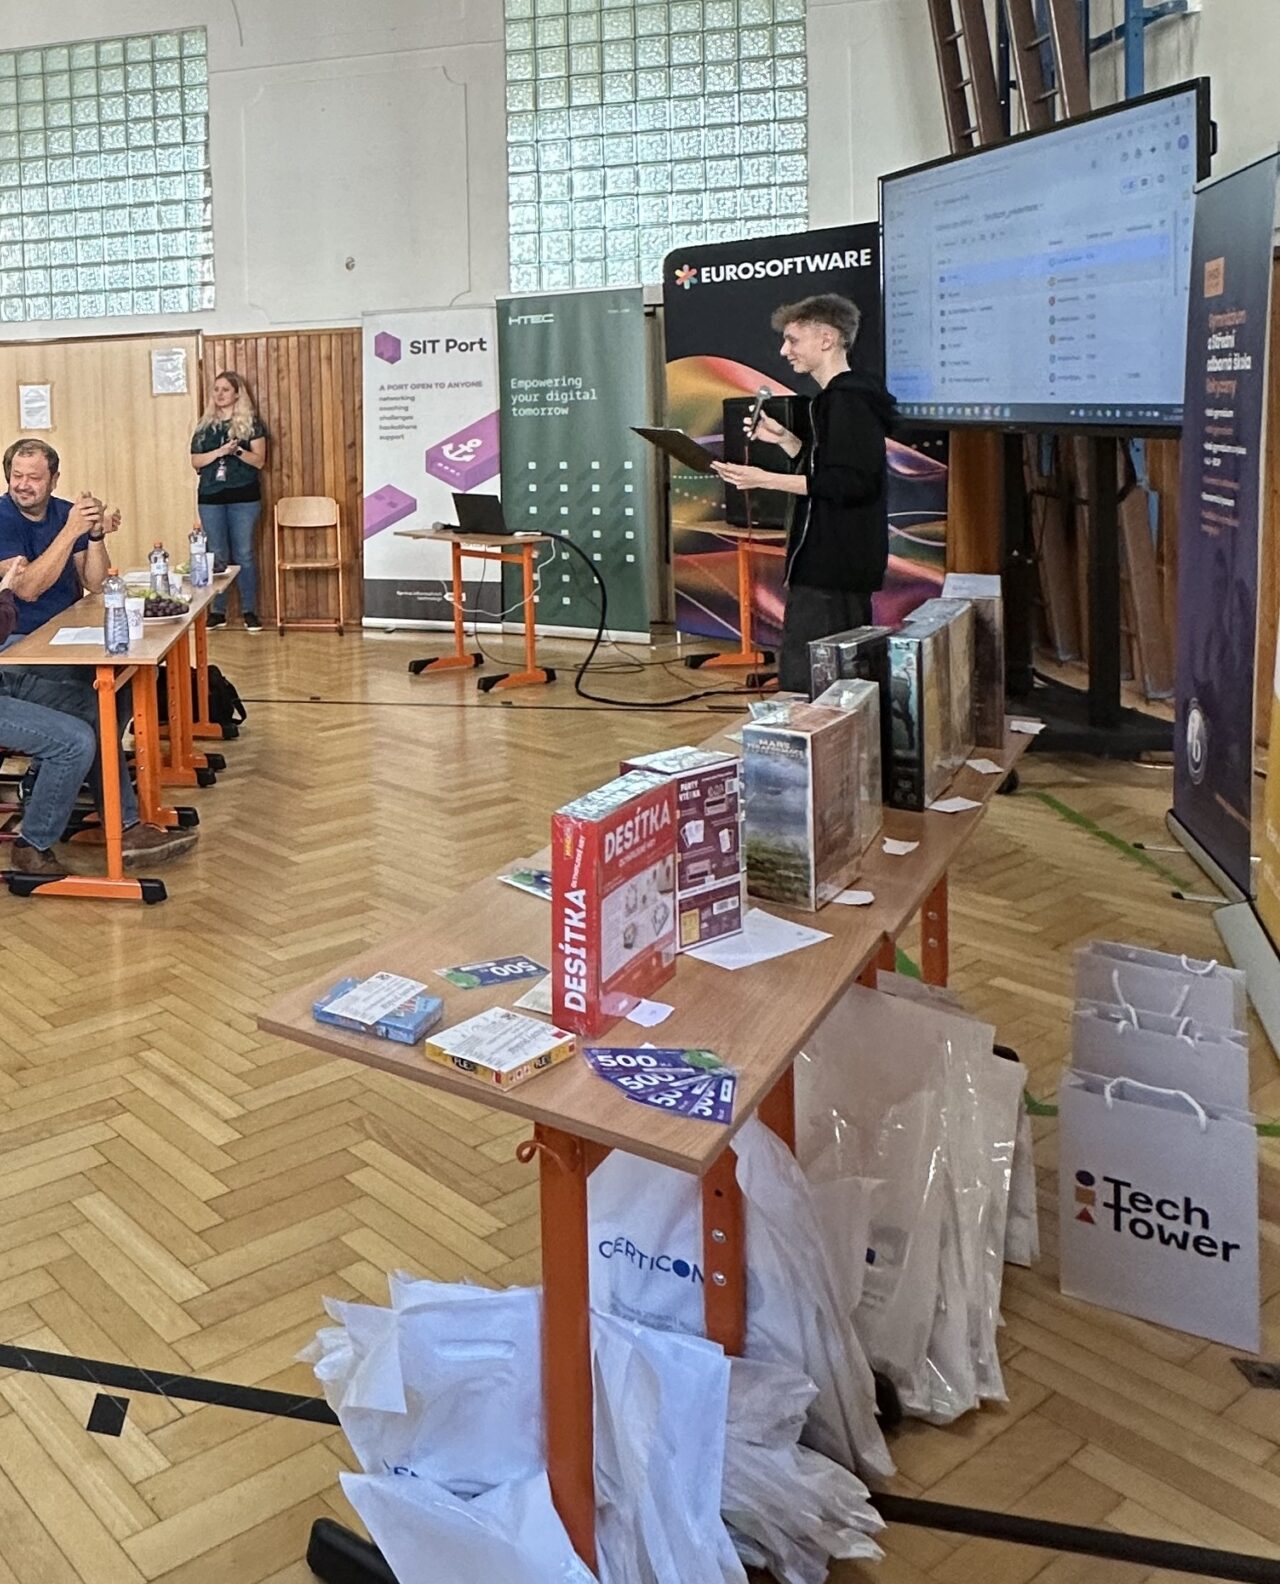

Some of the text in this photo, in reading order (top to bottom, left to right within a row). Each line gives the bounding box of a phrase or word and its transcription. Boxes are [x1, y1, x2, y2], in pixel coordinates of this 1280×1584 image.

[700, 248, 872, 284] EUROSOFTWARE
[508, 313, 554, 326] HTEC
[410, 337, 487, 355] SIT Port
[1233, 352, 1251, 370] škola
[379, 380, 483, 391] A PORT OPEN TO ANYONE
[510, 376, 583, 390] Empowering
[511, 388, 598, 405] your digital
[379, 414, 413, 422] challenges
[511, 406, 569, 417] tomorrow
[379, 433, 405, 441] support
[604, 801, 671, 864] DESÍTKA
[558, 888, 587, 1013] DESÍTKA
[490, 961, 538, 976] 500
[597, 1055, 658, 1067] 500
[618, 1073, 675, 1090] 500
[648, 1089, 683, 1107] 50
[1103, 1176, 1209, 1231] Tech
[1103, 1201, 1240, 1262] Tower
